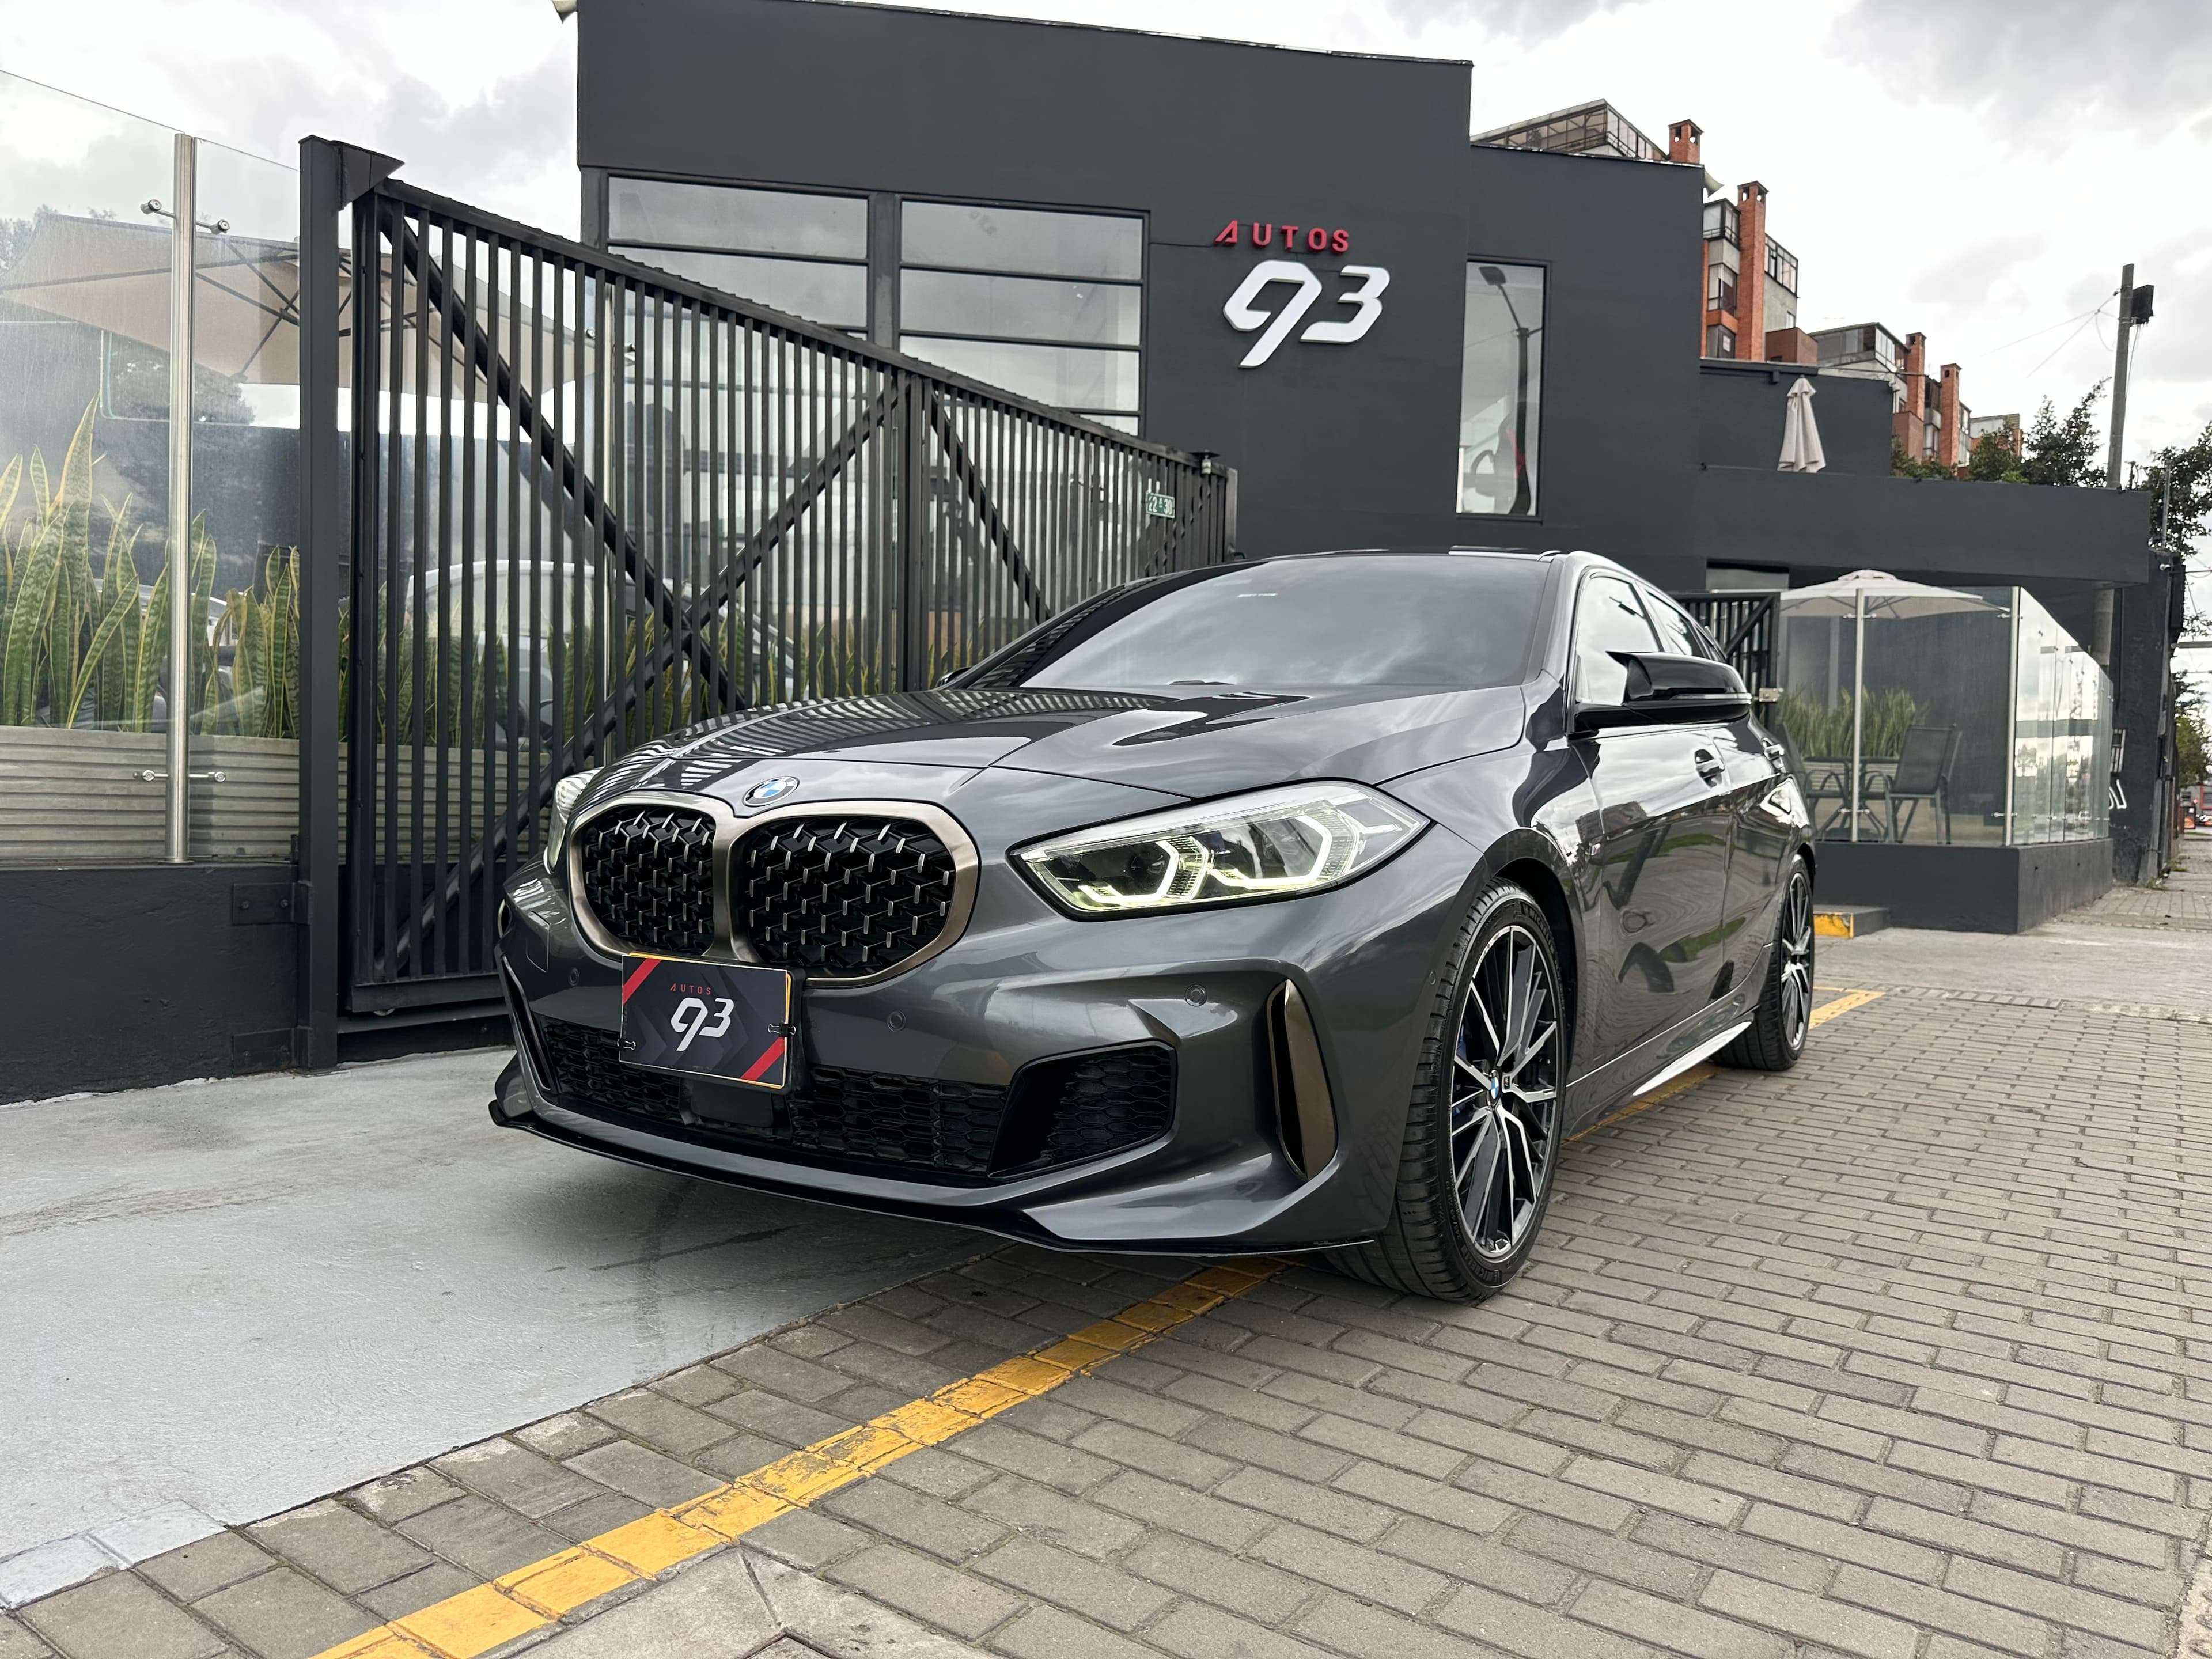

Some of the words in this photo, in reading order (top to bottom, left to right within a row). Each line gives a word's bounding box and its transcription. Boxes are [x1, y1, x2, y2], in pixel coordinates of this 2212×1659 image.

[1214, 220, 1350, 253] AUTOS
[1222, 260, 1390, 368] 93
[670, 983, 711, 995] AUTOS
[671, 997, 734, 1051] 93
